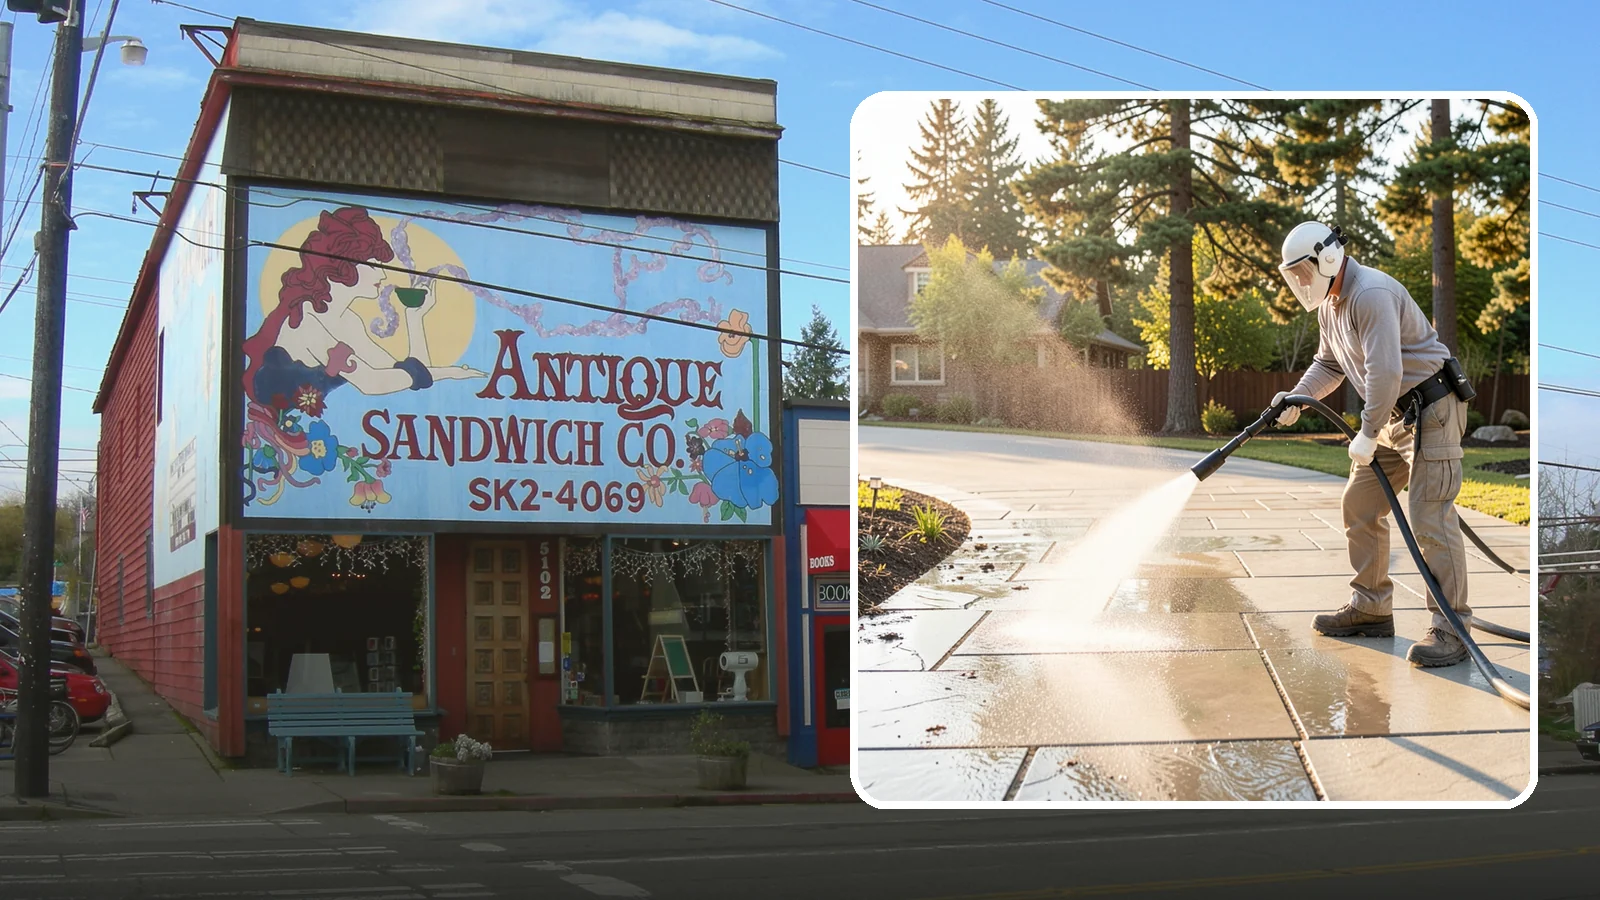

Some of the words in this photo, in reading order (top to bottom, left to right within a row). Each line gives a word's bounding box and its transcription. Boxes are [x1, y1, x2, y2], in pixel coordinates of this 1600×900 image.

[476, 329, 723, 420] ANTIQUE
[362, 408, 604, 467] SANDWICH
[617, 421, 685, 469] CO.
[468, 477, 645, 512] SK2-4069
[540, 541, 551, 600] 5102
[809, 555, 835, 569] BOOKS
